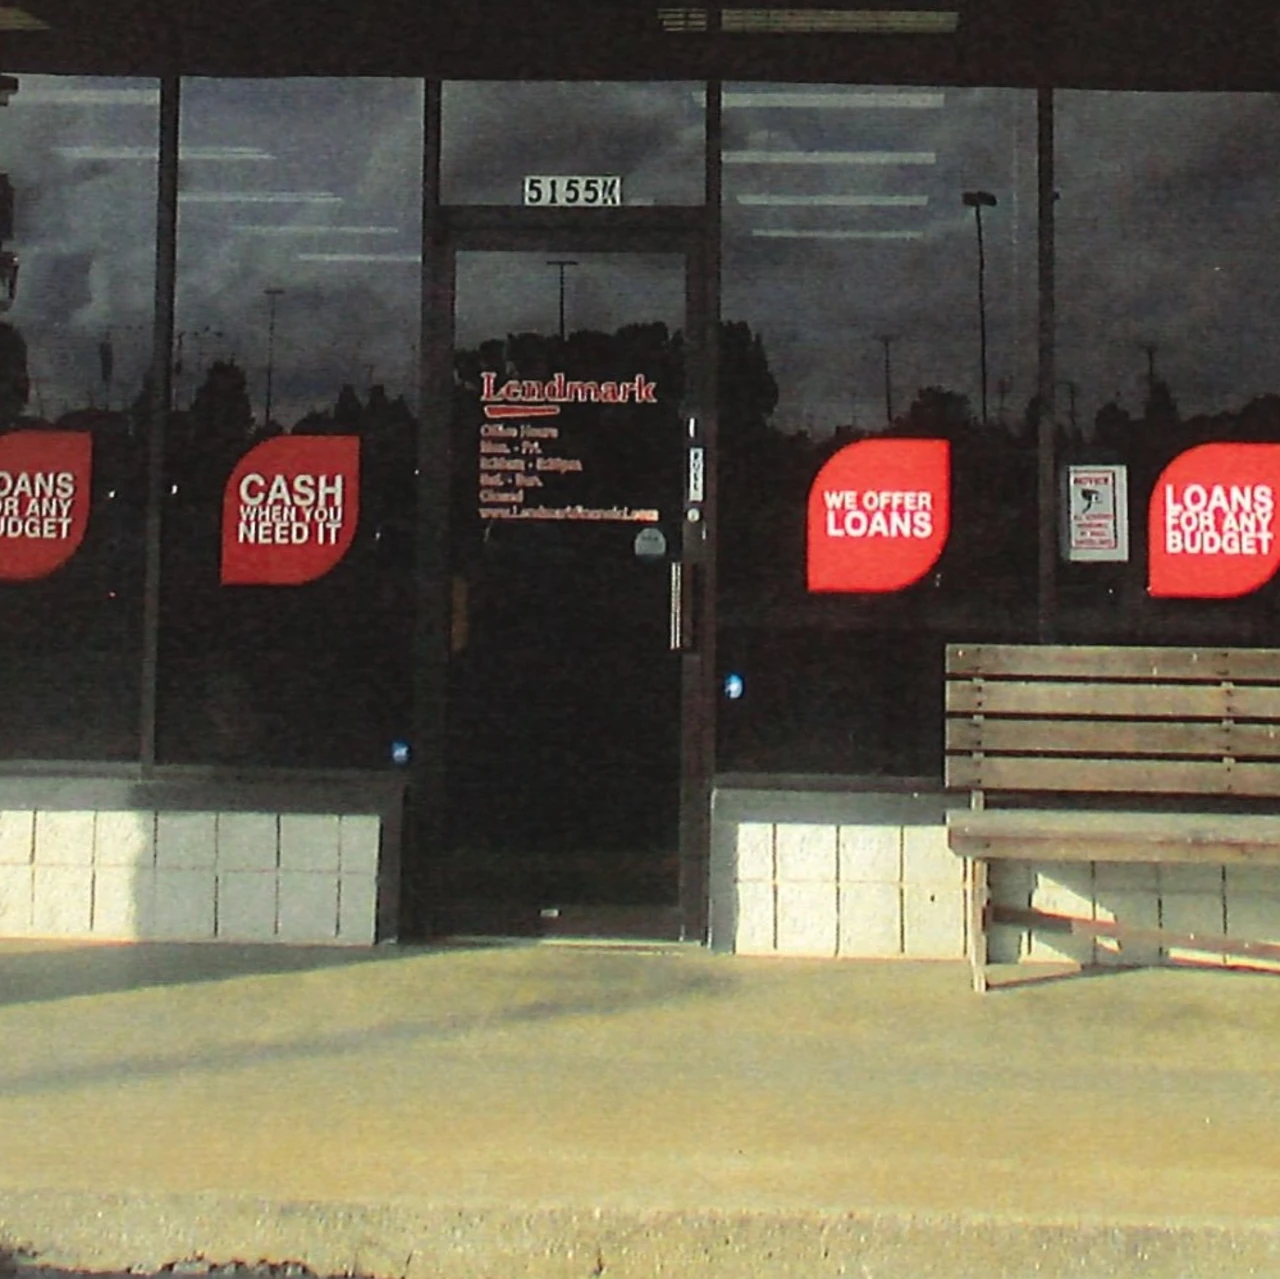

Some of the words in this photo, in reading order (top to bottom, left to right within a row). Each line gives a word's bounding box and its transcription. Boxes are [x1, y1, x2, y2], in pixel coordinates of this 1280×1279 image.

[480, 371, 658, 403] Lendmark
[238, 473, 343, 507] CASH
[824, 490, 858, 510] WE
[862, 491, 932, 511] OFFER
[1165, 484, 1274, 512] LOANS
[28, 498, 73, 519] ANY
[239, 505, 296, 522] WHEN
[302, 506, 343, 523] YOU
[237, 522, 310, 544] NEED
[317, 522, 342, 545] IT
[826, 510, 933, 538] LOANS
[1166, 511, 1215, 533] FOR
[1222, 511, 1272, 533] ANY
[1165, 531, 1274, 554] BUDGET
